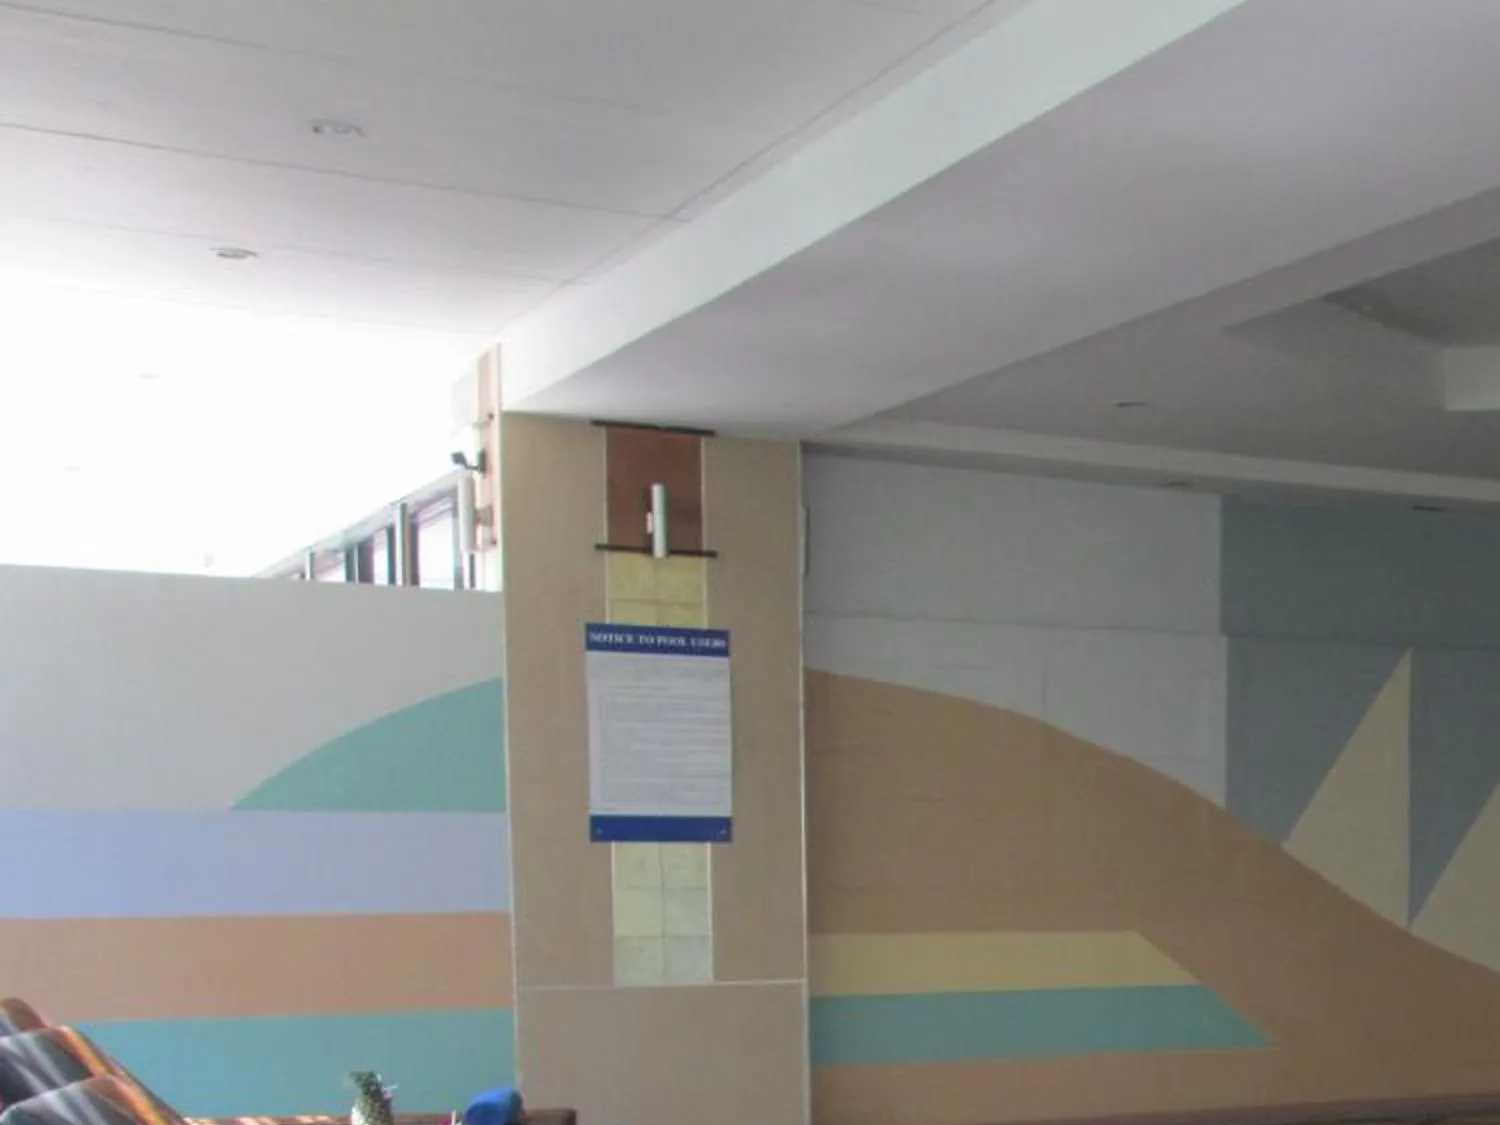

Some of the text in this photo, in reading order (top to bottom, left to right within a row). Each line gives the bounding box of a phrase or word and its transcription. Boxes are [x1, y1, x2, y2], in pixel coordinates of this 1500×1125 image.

[590, 632, 633, 644] NOTICE
[640, 635, 655, 645] TO
[657, 635, 686, 646] POOL
